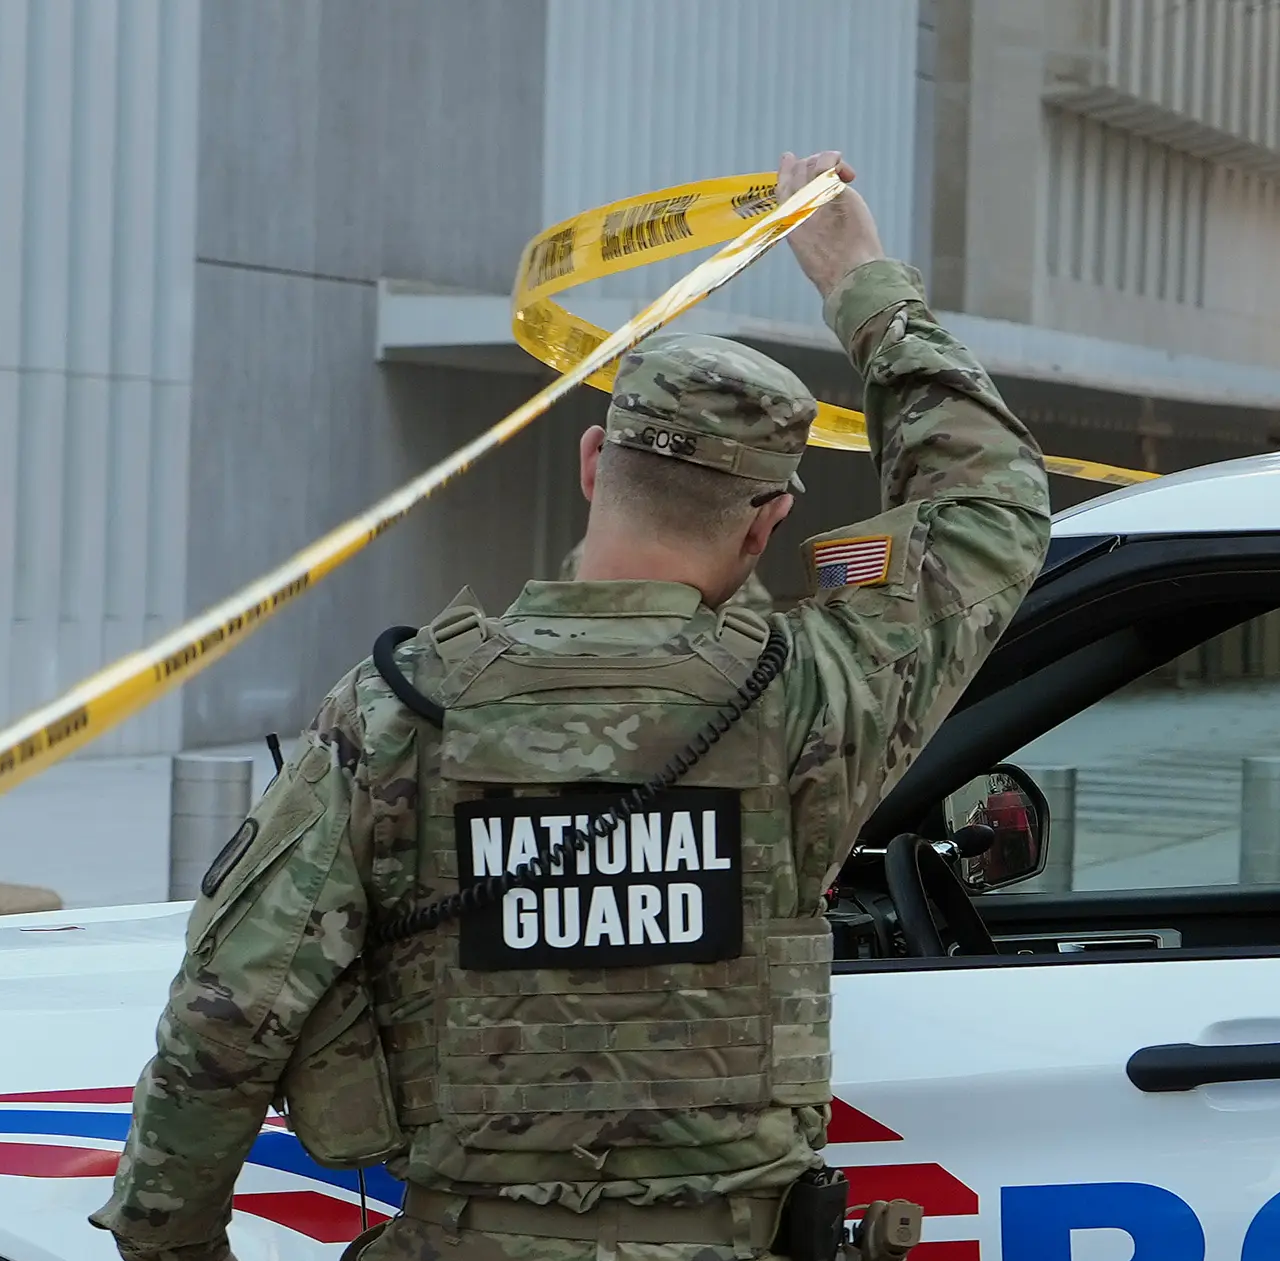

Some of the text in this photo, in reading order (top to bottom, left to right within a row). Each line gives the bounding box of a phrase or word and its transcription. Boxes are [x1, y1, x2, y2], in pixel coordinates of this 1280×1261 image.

[641, 426, 698, 456] GOSS
[469, 809, 732, 878] NATIONAL
[501, 882, 705, 950] GUARD
